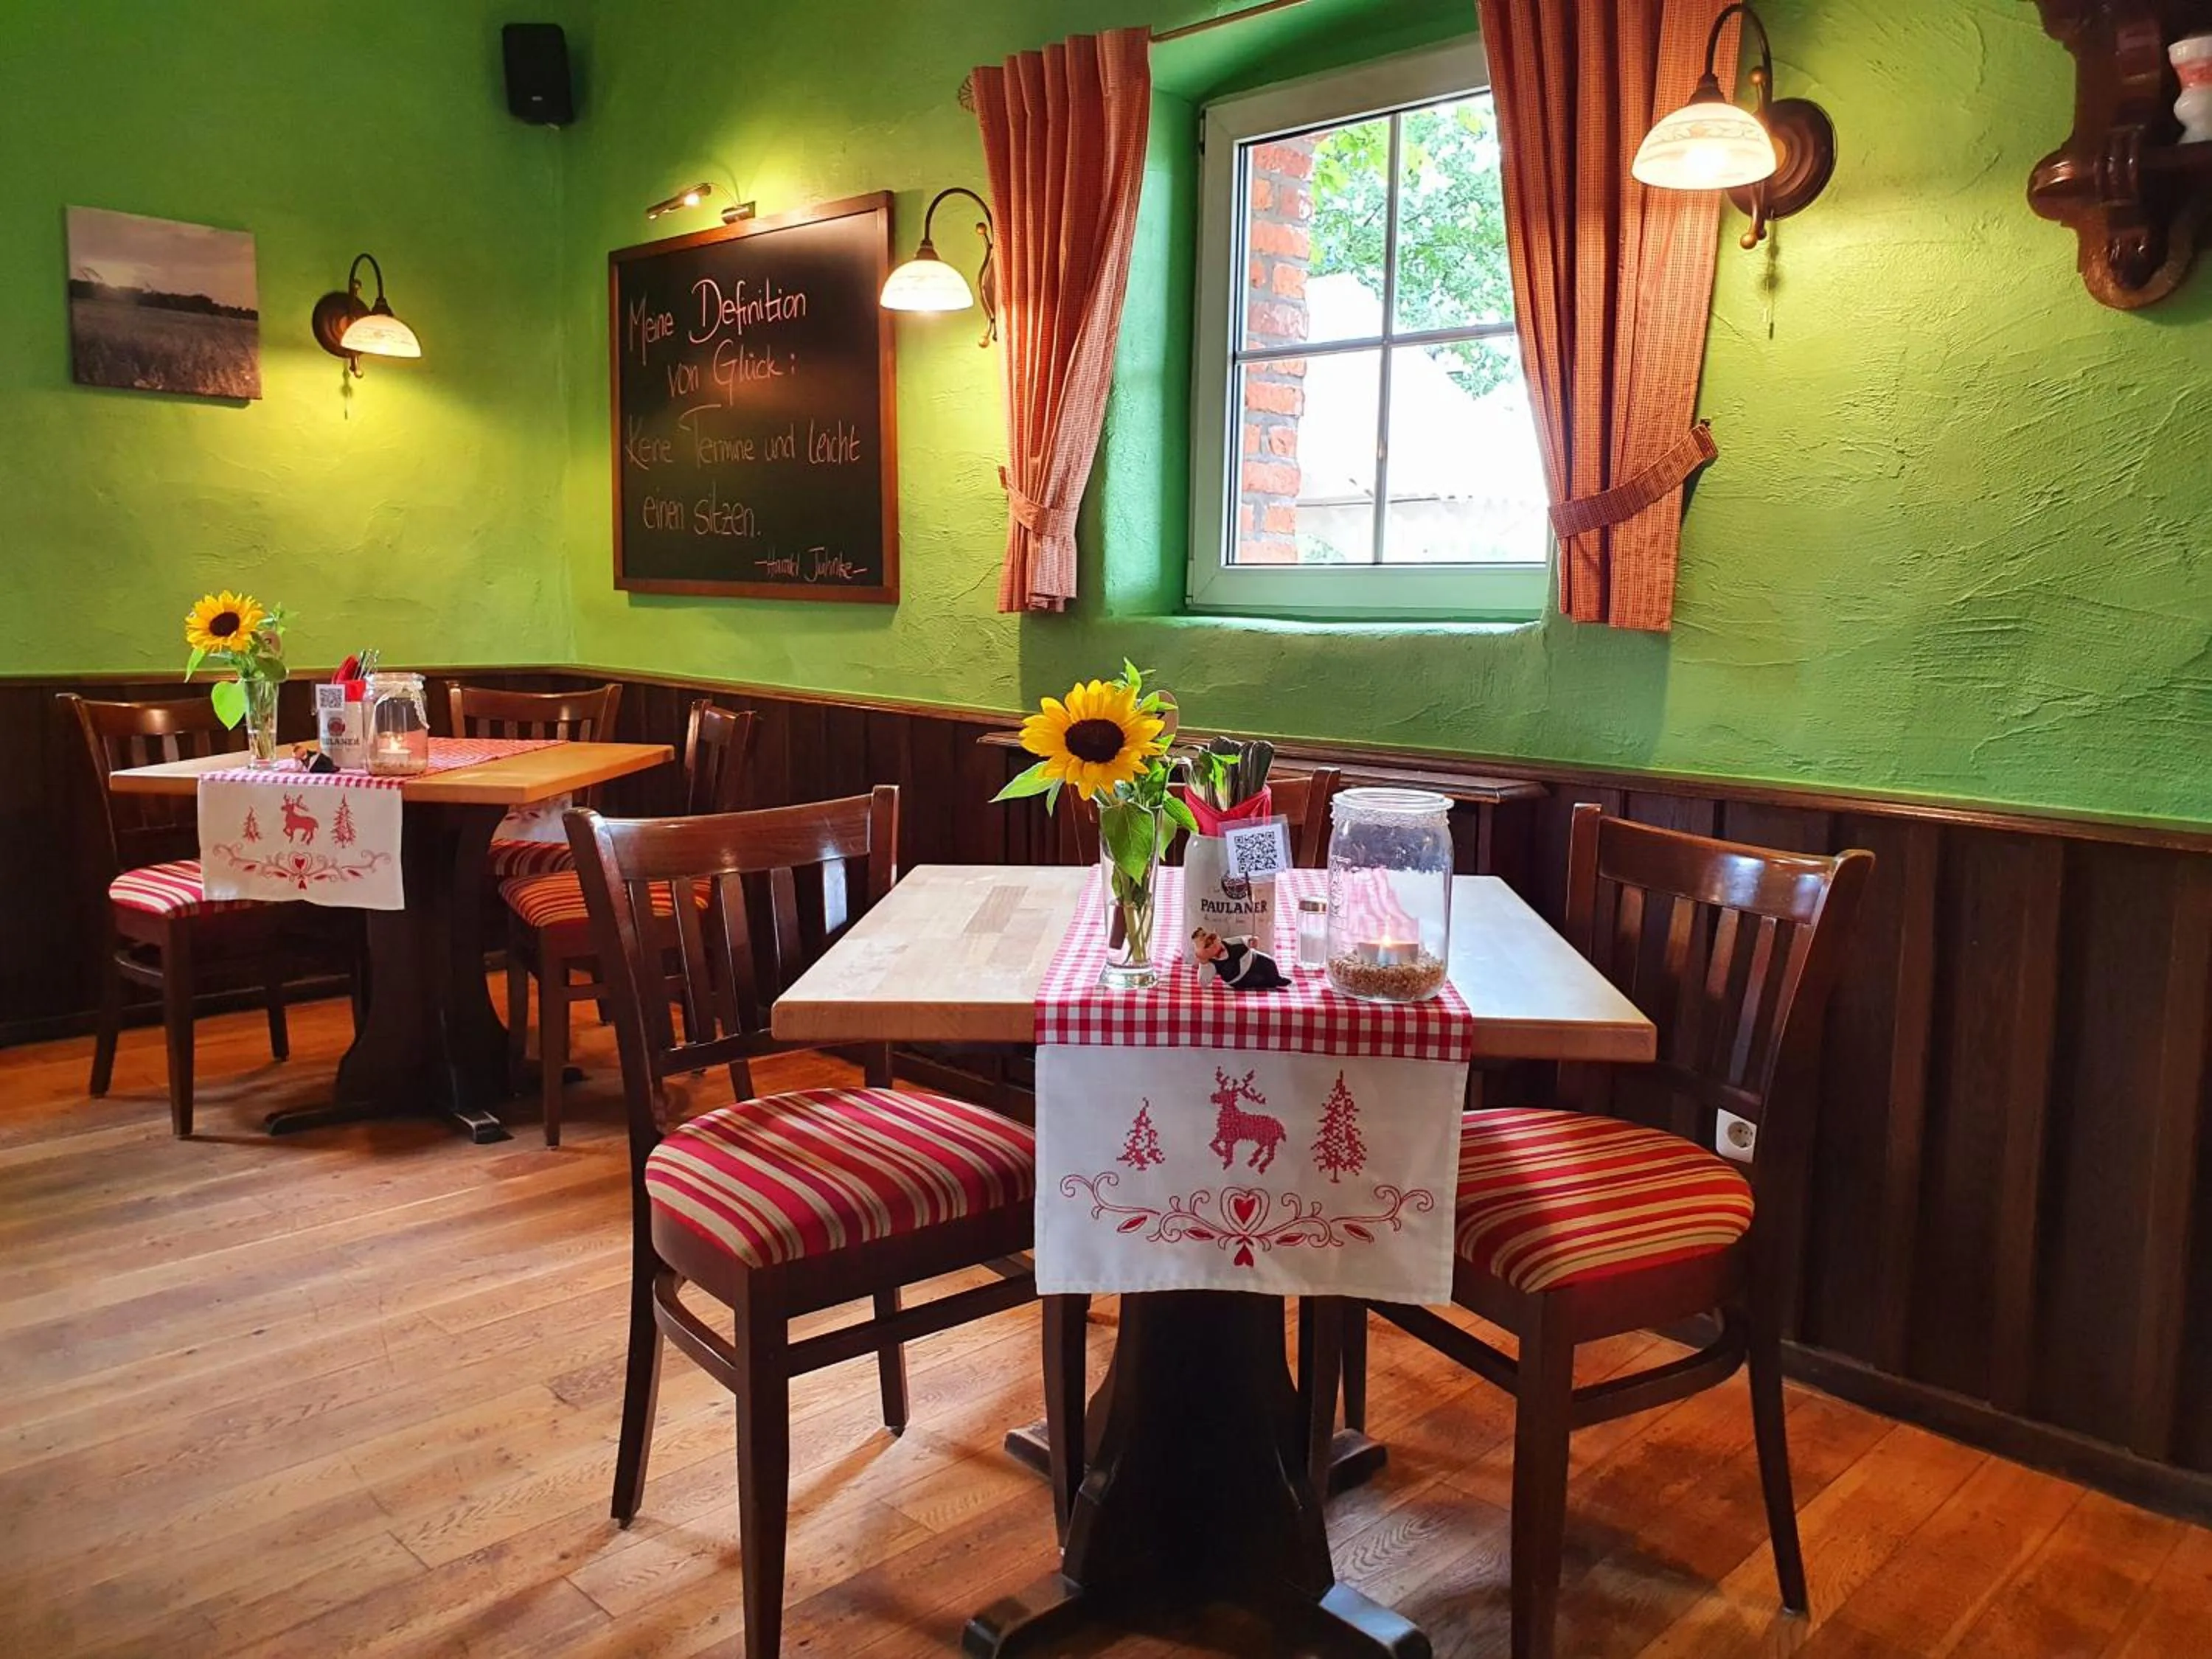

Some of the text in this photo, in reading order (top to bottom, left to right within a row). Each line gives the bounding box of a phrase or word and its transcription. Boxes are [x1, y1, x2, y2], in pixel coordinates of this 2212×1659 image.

[689, 277, 807, 344] Definition
[668, 361, 699, 397] von
[765, 422, 796, 462] und
[644, 486, 684, 530] einen
[1200, 898, 1267, 914] PAULANER
